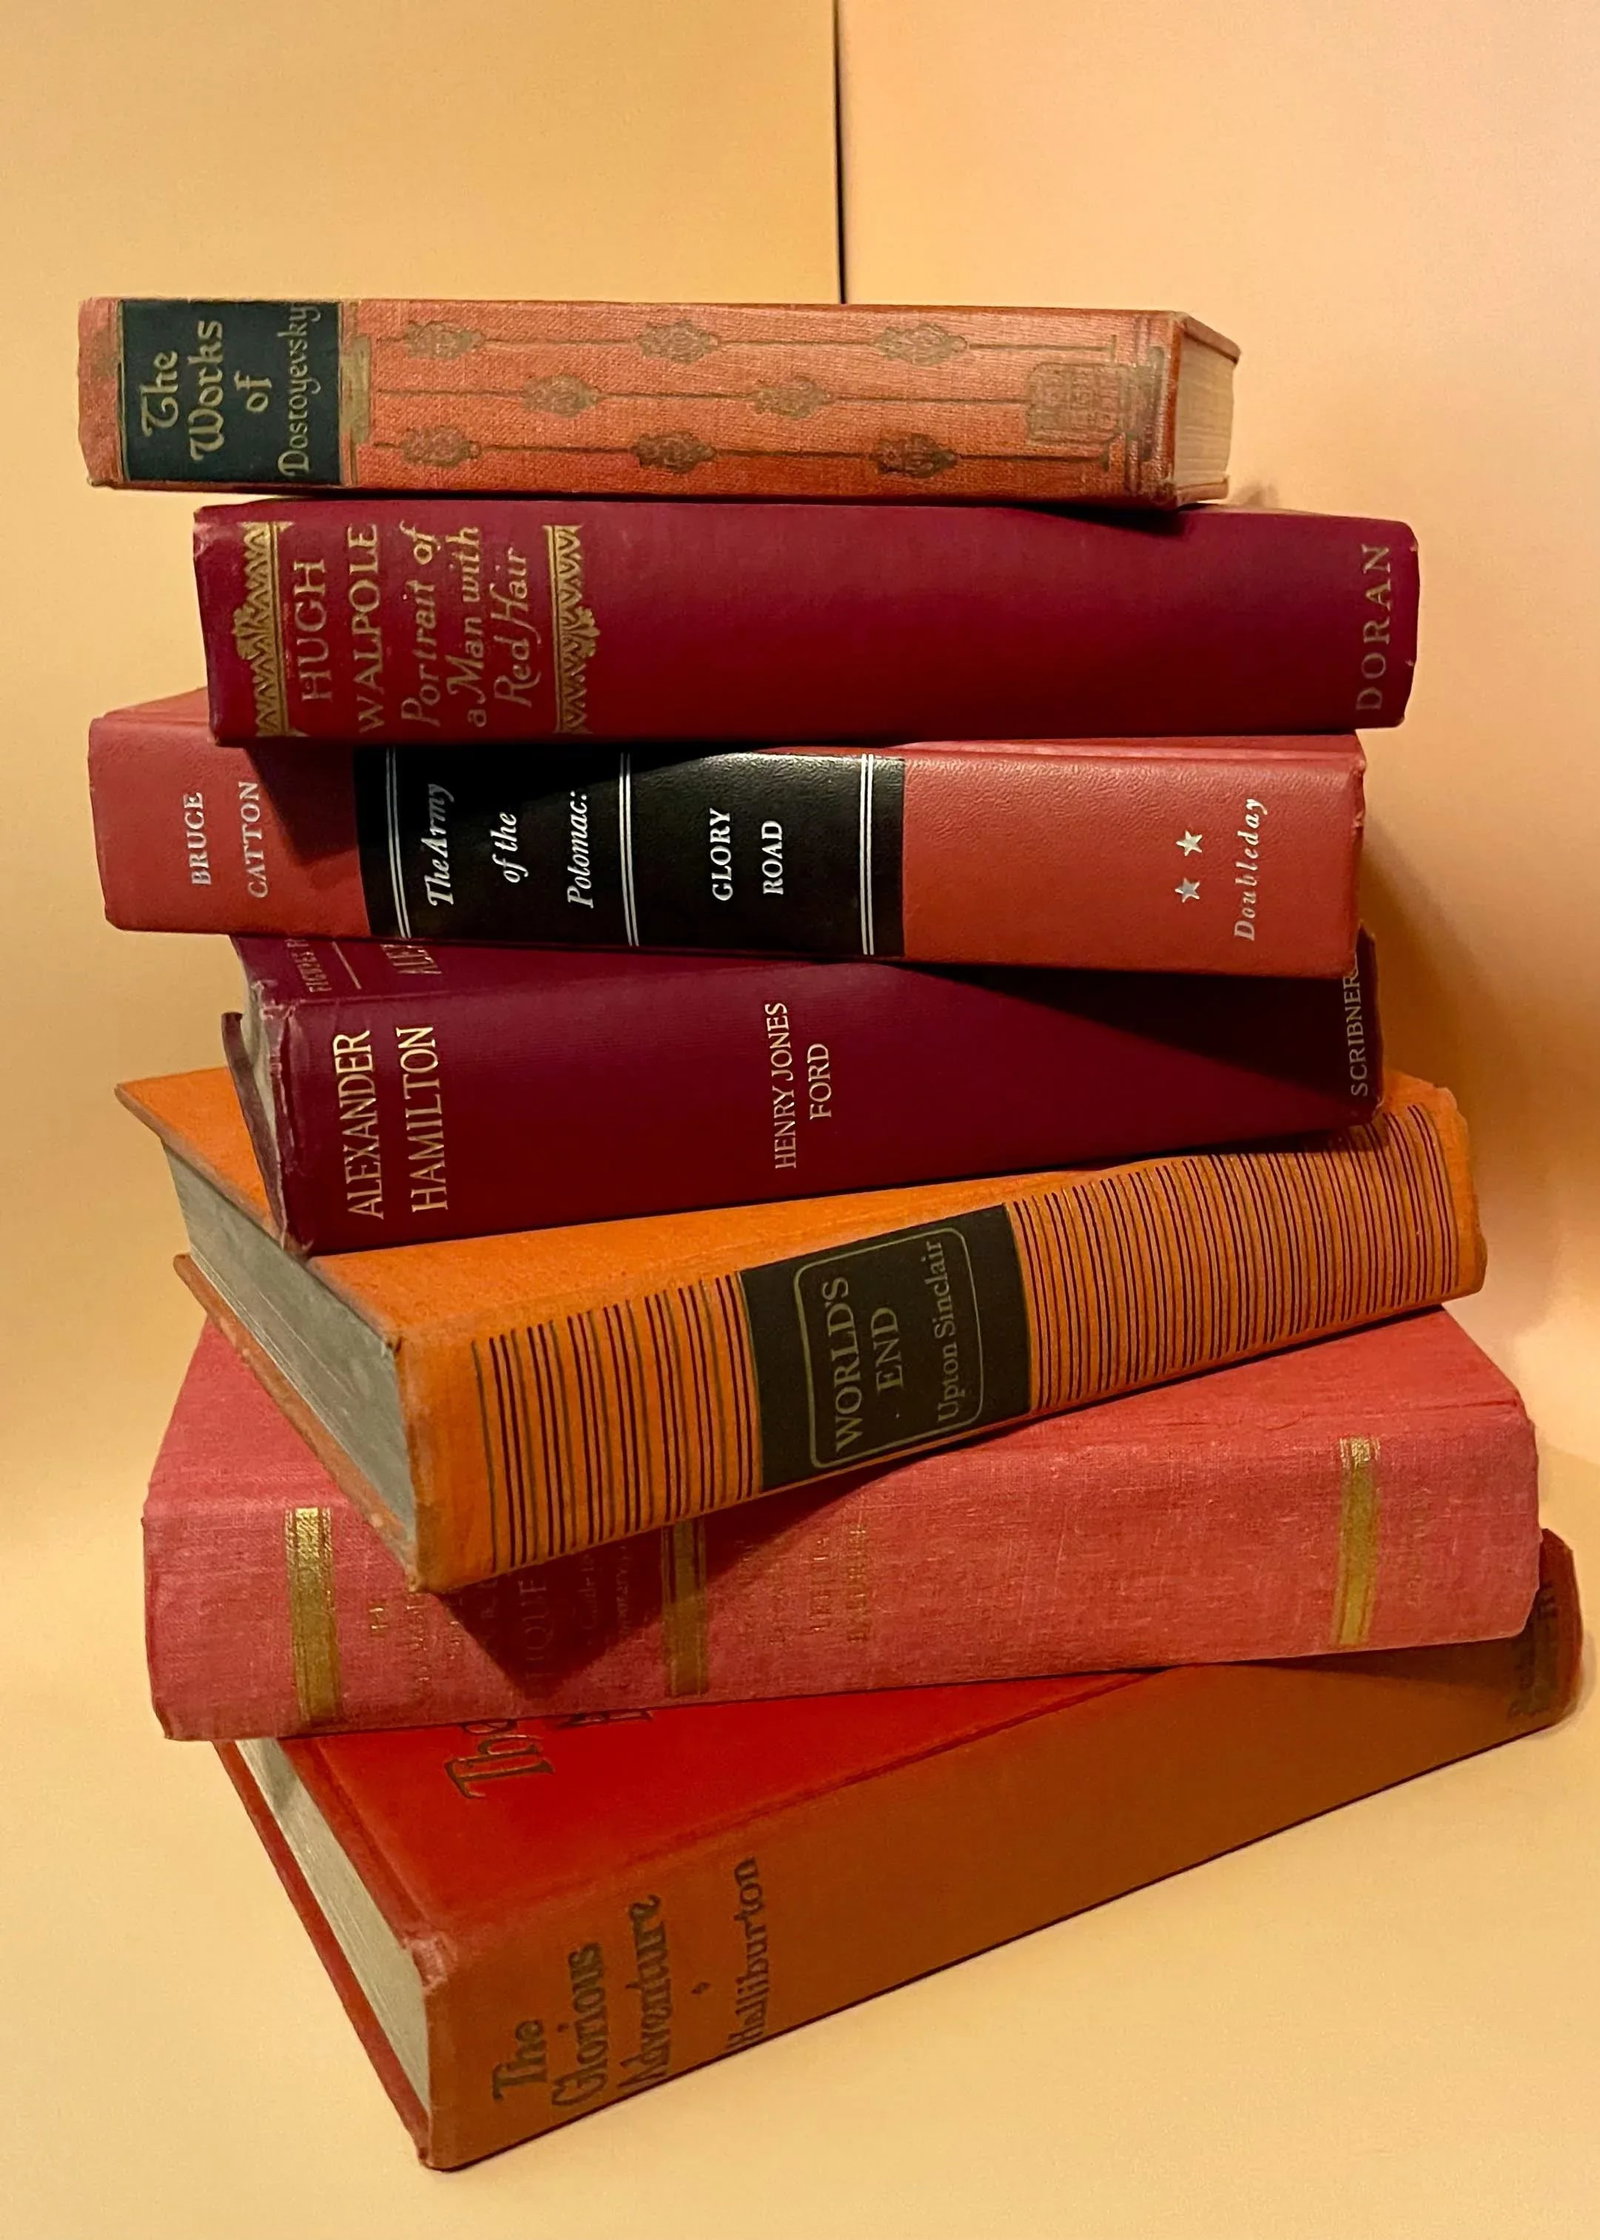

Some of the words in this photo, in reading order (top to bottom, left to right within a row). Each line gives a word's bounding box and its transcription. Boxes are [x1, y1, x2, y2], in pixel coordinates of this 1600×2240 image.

[142, 350, 180, 437] The
[187, 319, 226, 462] Works
[234, 369, 273, 414] of
[276, 301, 322, 478] Dostoyevsky
[399, 519, 443, 567] of
[445, 524, 482, 604] with
[293, 557, 334, 702] HUGH
[346, 521, 386, 734] WALPOLE
[490, 546, 543, 646] Hair
[1355, 543, 1392, 712] DORAN
[400, 578, 442, 729] Portrait
[444, 615, 486, 706] Man
[491, 628, 543, 709] Red
[465, 706, 488, 729] a
[183, 791, 212, 887] BRUCE
[237, 780, 270, 899] CATTON
[420, 782, 455, 858] Army
[489, 812, 518, 852] the
[491, 848, 529, 884] of
[708, 807, 734, 902] GLORY
[761, 819, 785, 896] ROAD
[423, 857, 454, 907] The
[1233, 797, 1268, 942] Doubleday
[764, 1001, 795, 1082] JONES
[806, 1043, 832, 1121] FORD
[332, 1029, 385, 1220] ALEXANDER
[395, 1026, 449, 1213] HAMILTON
[771, 1084, 797, 1169] HENRY
[920, 1240, 957, 1339] Sinclair
[821, 1276, 864, 1454] WORLD'S
[870, 1306, 904, 1396] END
[937, 1342, 966, 1422] Upton
[616, 1893, 673, 2090] Adventure
[726, 1857, 770, 2050] Halliburton
[492, 2018, 547, 2102] The
[551, 1941, 609, 2106] Glorious
